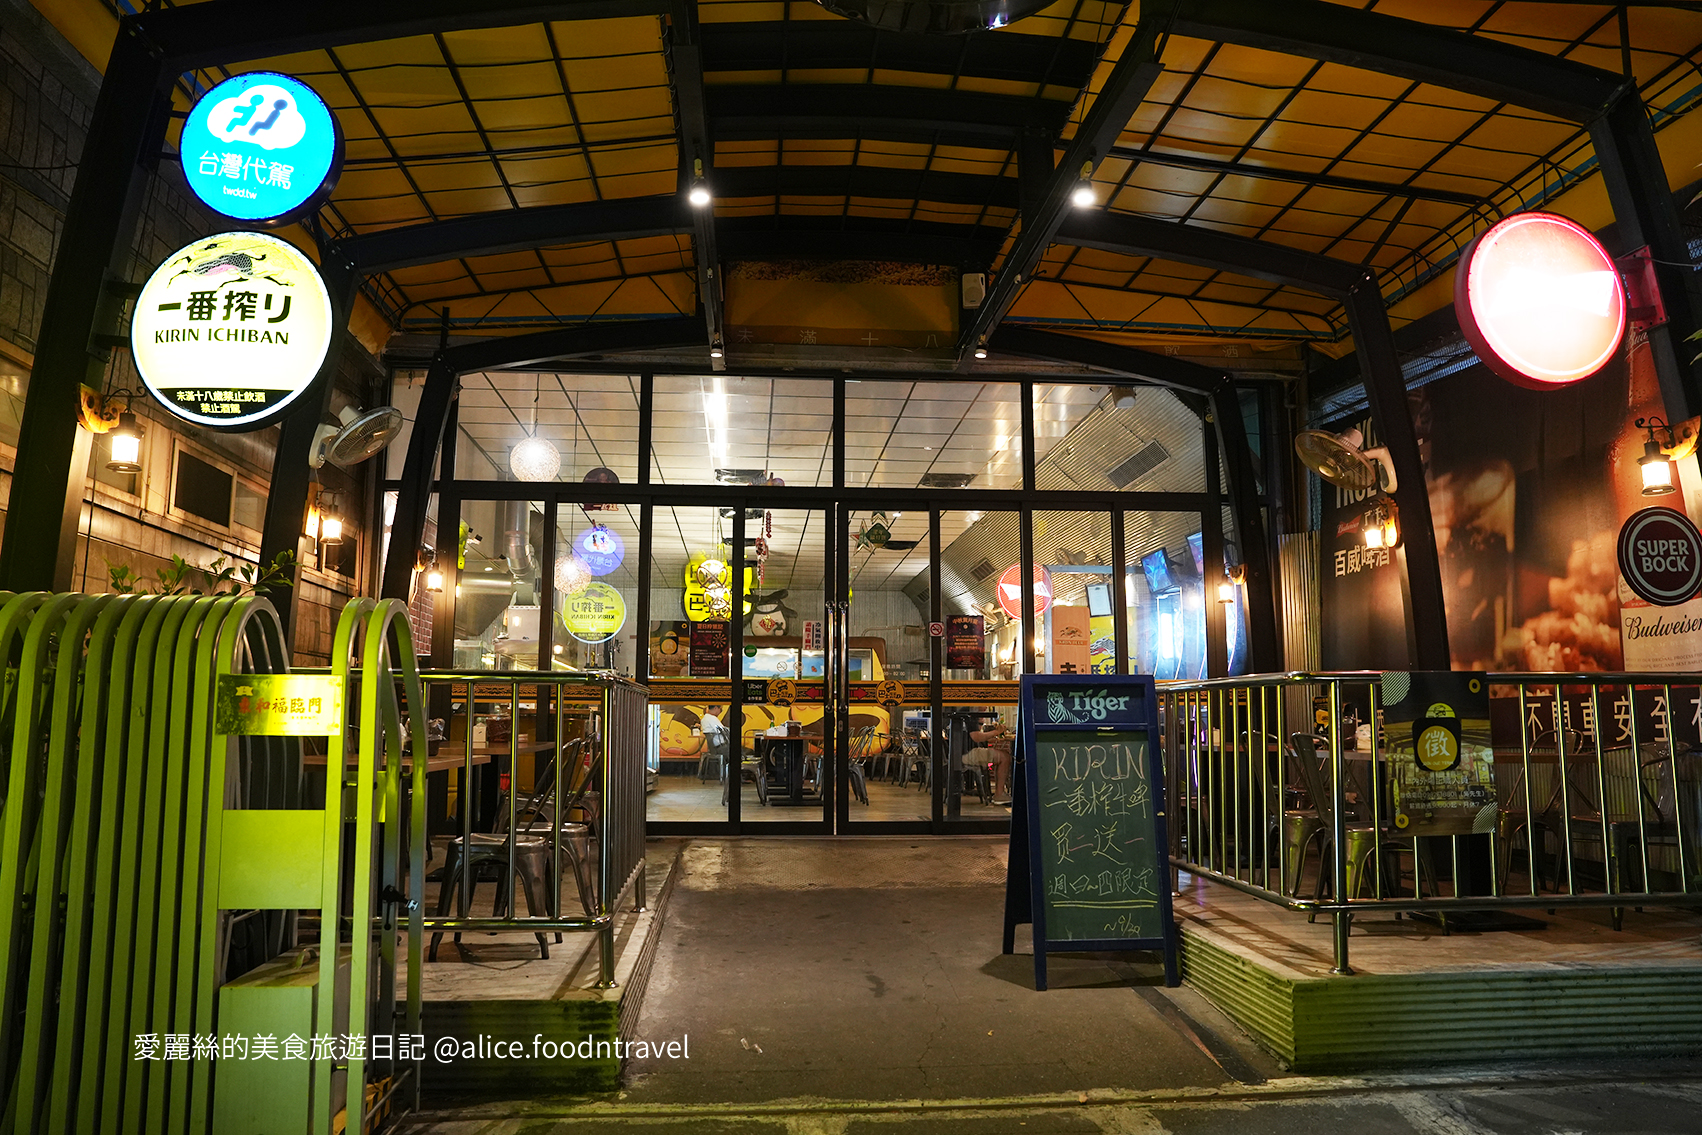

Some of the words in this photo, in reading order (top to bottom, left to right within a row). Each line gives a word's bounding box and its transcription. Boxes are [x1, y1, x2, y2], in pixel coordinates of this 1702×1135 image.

[199, 150, 294, 190] 台灣代駕
[222, 184, 258, 200] twdd.tw
[157, 289, 292, 324] 一番搾り
[154, 328, 200, 344] KIRIN
[207, 327, 289, 345] ICHIBAN
[176, 390, 266, 403] 未滿十八歲禁止飲酒
[1637, 538, 1690, 557] SUPER
[1642, 556, 1690, 573] BOCK
[1069, 689, 1130, 720] Tiger
[1424, 729, 1451, 758] 徵
[1051, 744, 1146, 782] KIRIN
